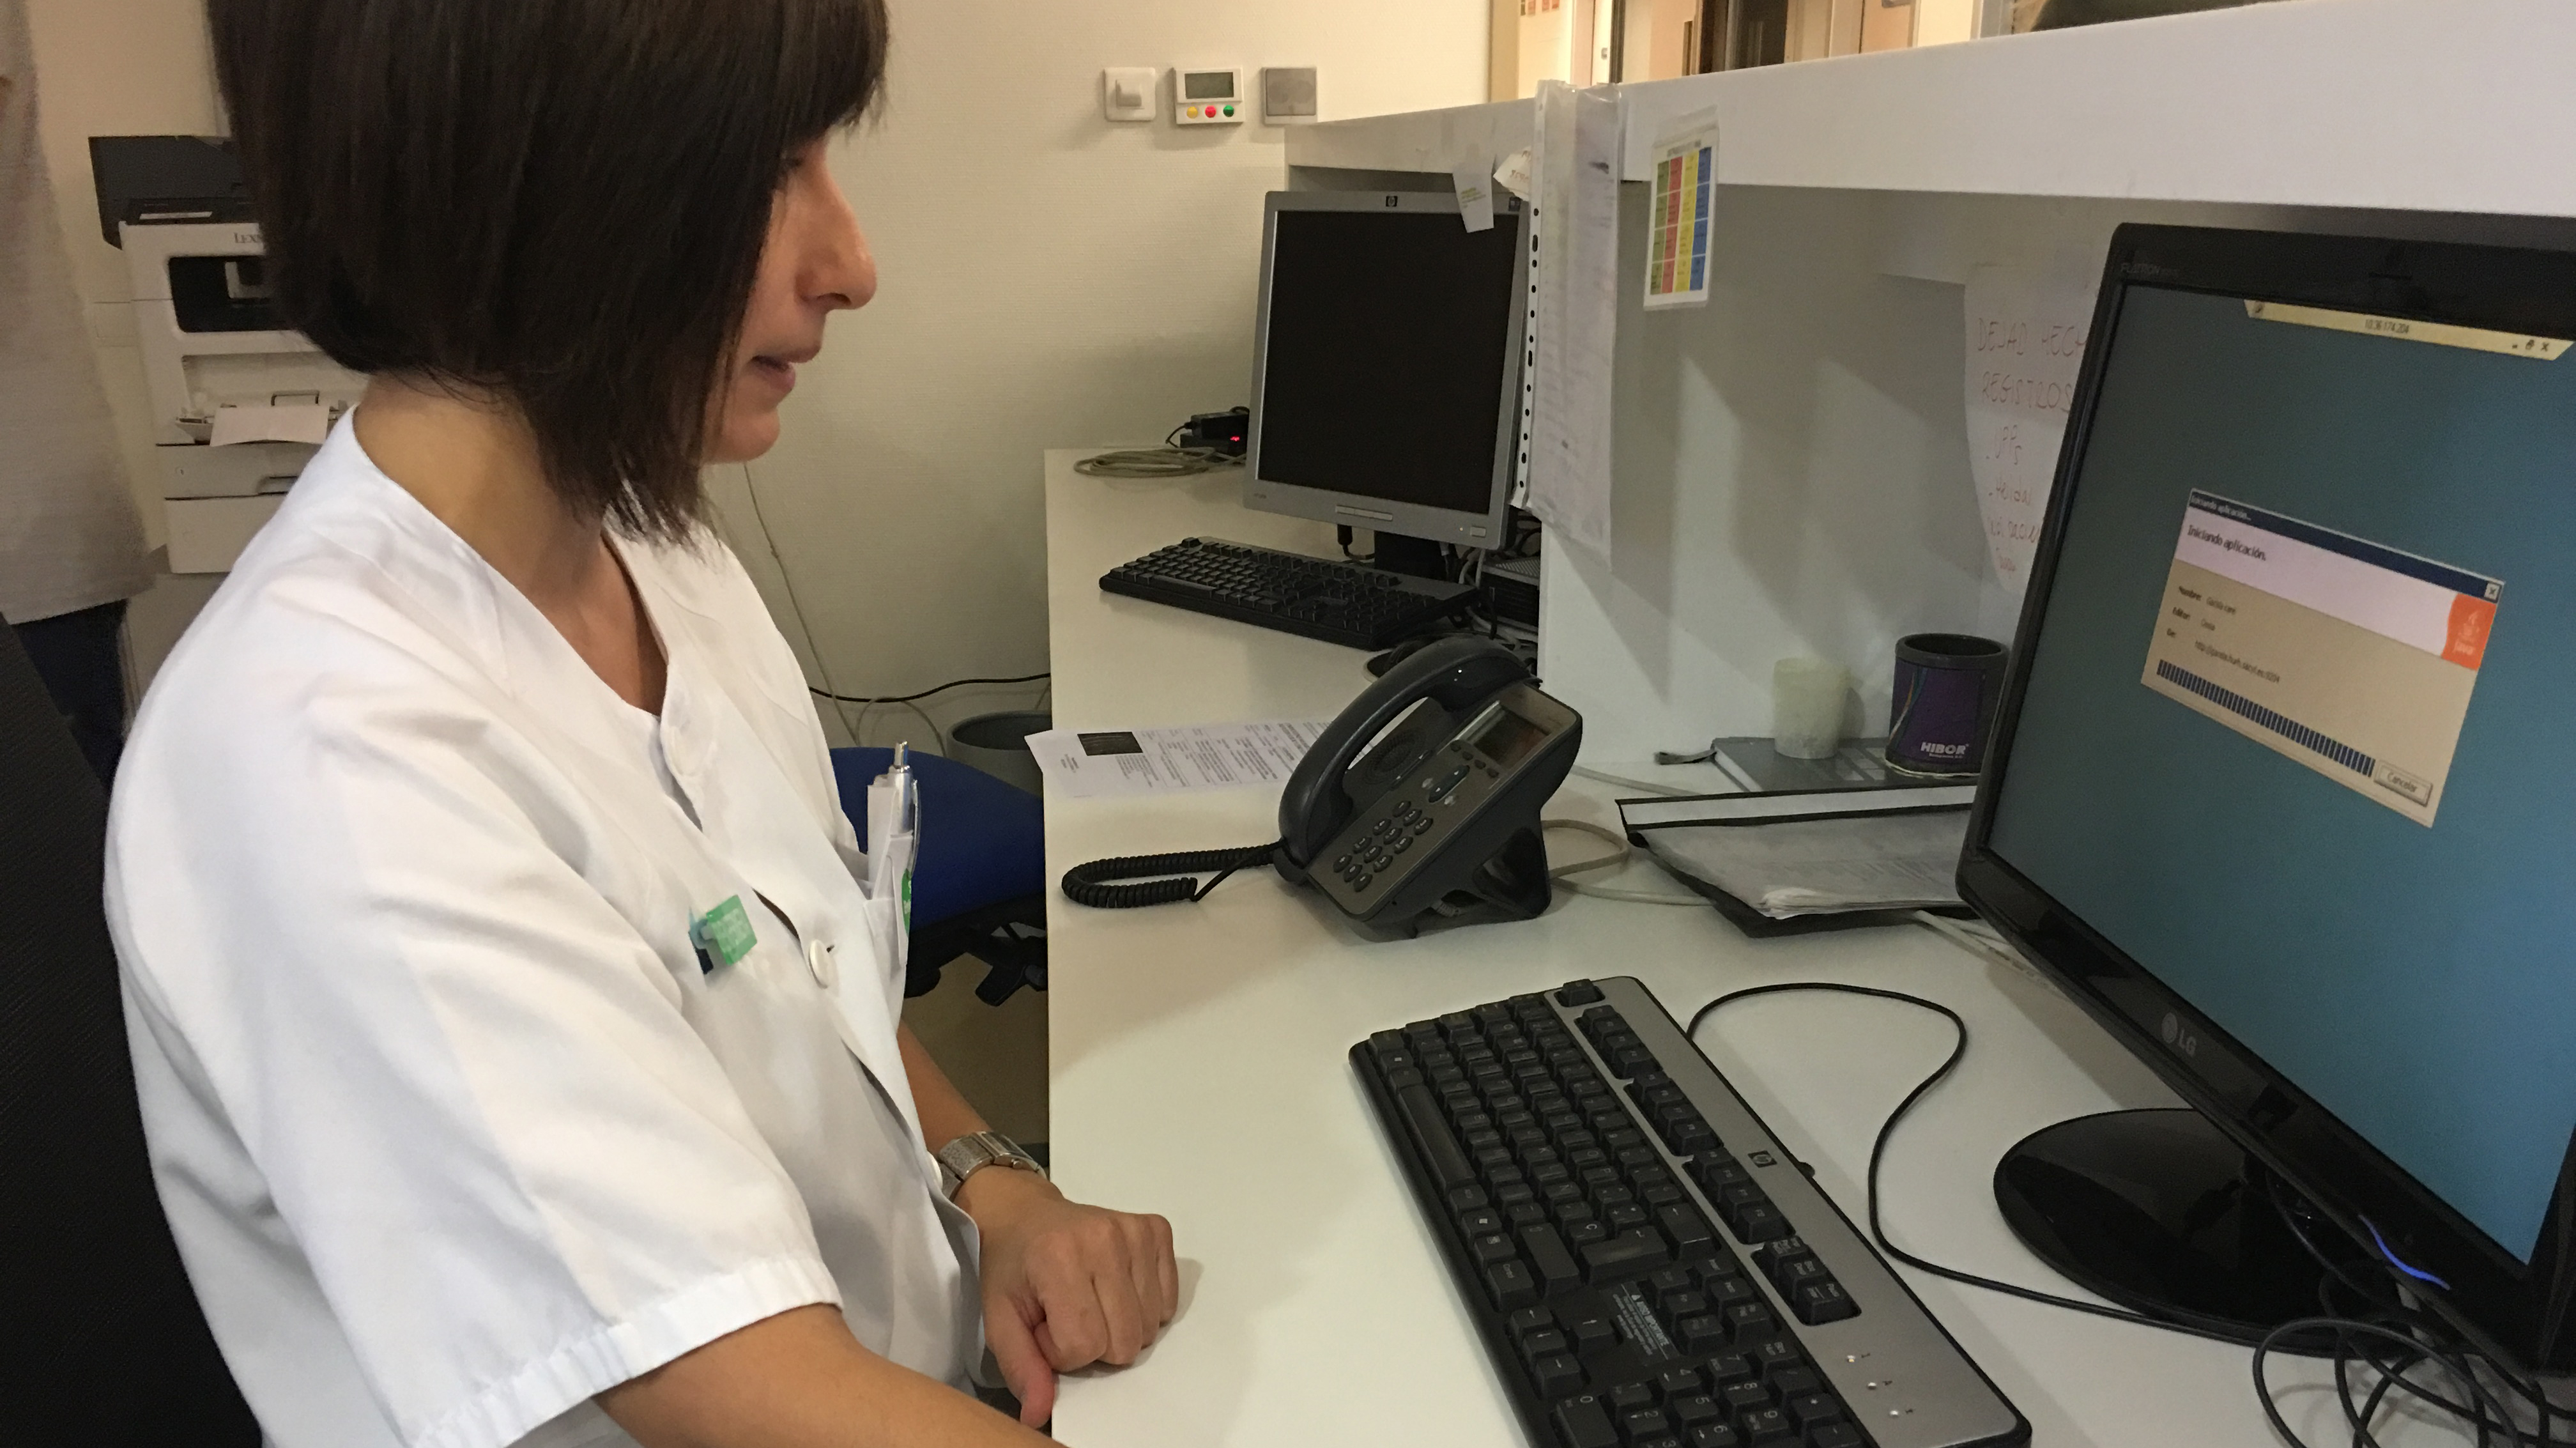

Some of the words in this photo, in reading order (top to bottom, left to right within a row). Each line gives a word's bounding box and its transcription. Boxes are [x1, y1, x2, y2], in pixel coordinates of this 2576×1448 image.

[2187, 524, 2223, 546] Iniciando
[2223, 539, 2267, 562] aplicación.
[1920, 741, 1966, 755] HIBOR
[2386, 770, 2418, 793] Cancelar
[2177, 1028, 2198, 1058] LG
[1726, 1352, 1742, 1362] 7
[1678, 1367, 1692, 1376] 4
[1743, 1381, 1759, 1390] 8
[1579, 1395, 1594, 1405] 0
[1694, 1396, 1712, 1405] 5
[1643, 1410, 1659, 1419] 2
[1763, 1409, 1779, 1419] 9
[1712, 1424, 1729, 1434] 6
